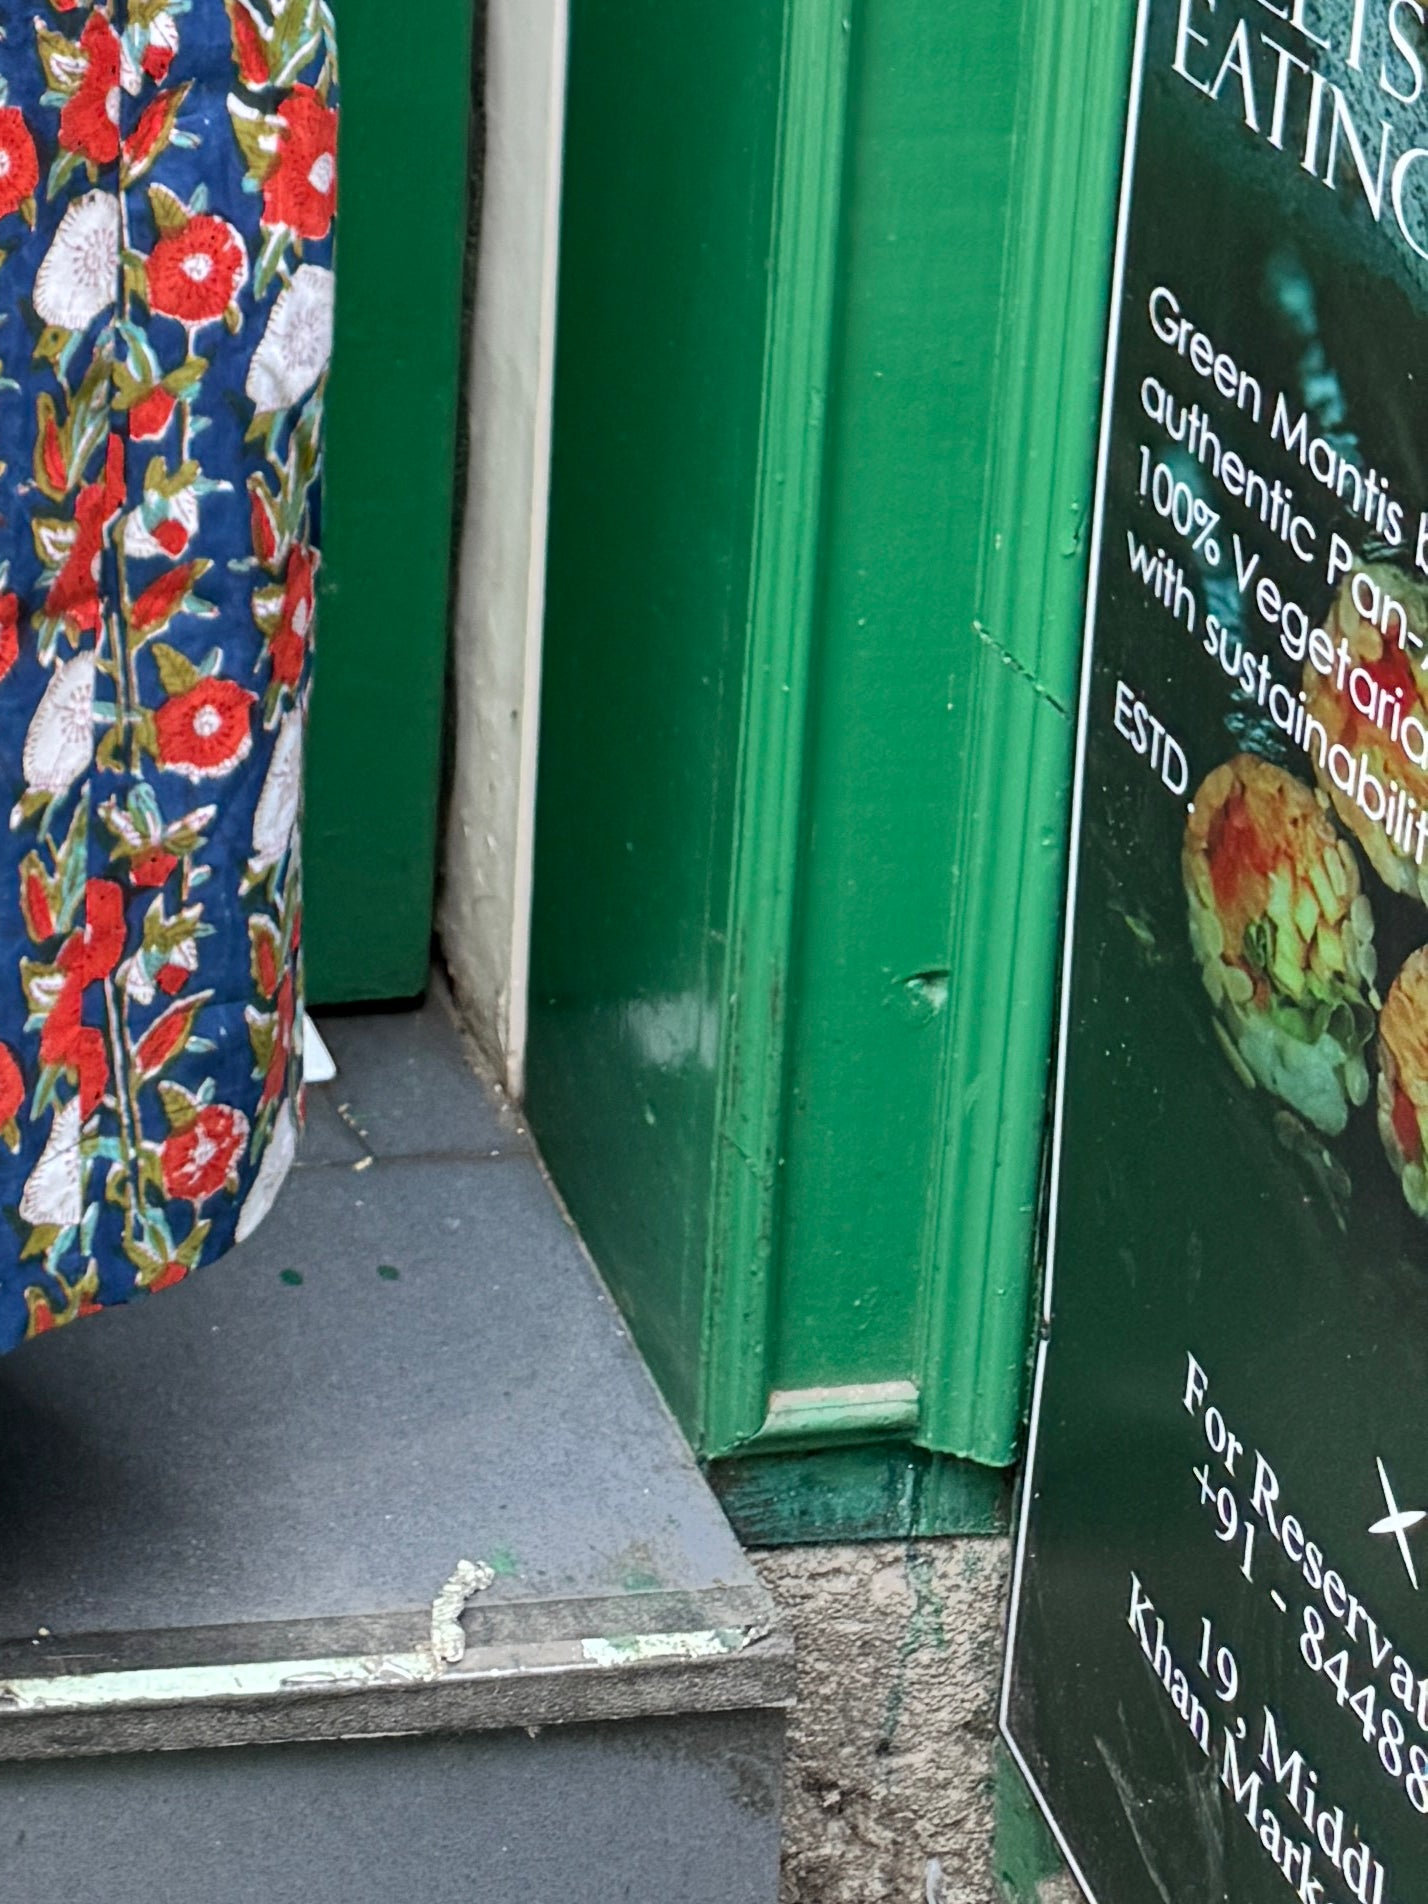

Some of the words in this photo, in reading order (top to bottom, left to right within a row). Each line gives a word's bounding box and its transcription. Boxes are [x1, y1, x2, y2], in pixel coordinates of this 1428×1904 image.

[1149, 286, 1261, 423] Green
[1271, 392, 1404, 545] Mantis
[1127, 530, 1196, 633] with
[1140, 445, 1220, 566] 100%
[1141, 377, 1316, 563] authentic
[1327, 533, 1428, 670] Pan-
[1182, 1350, 1243, 1477] For
[1127, 1571, 1210, 1757] Khan
